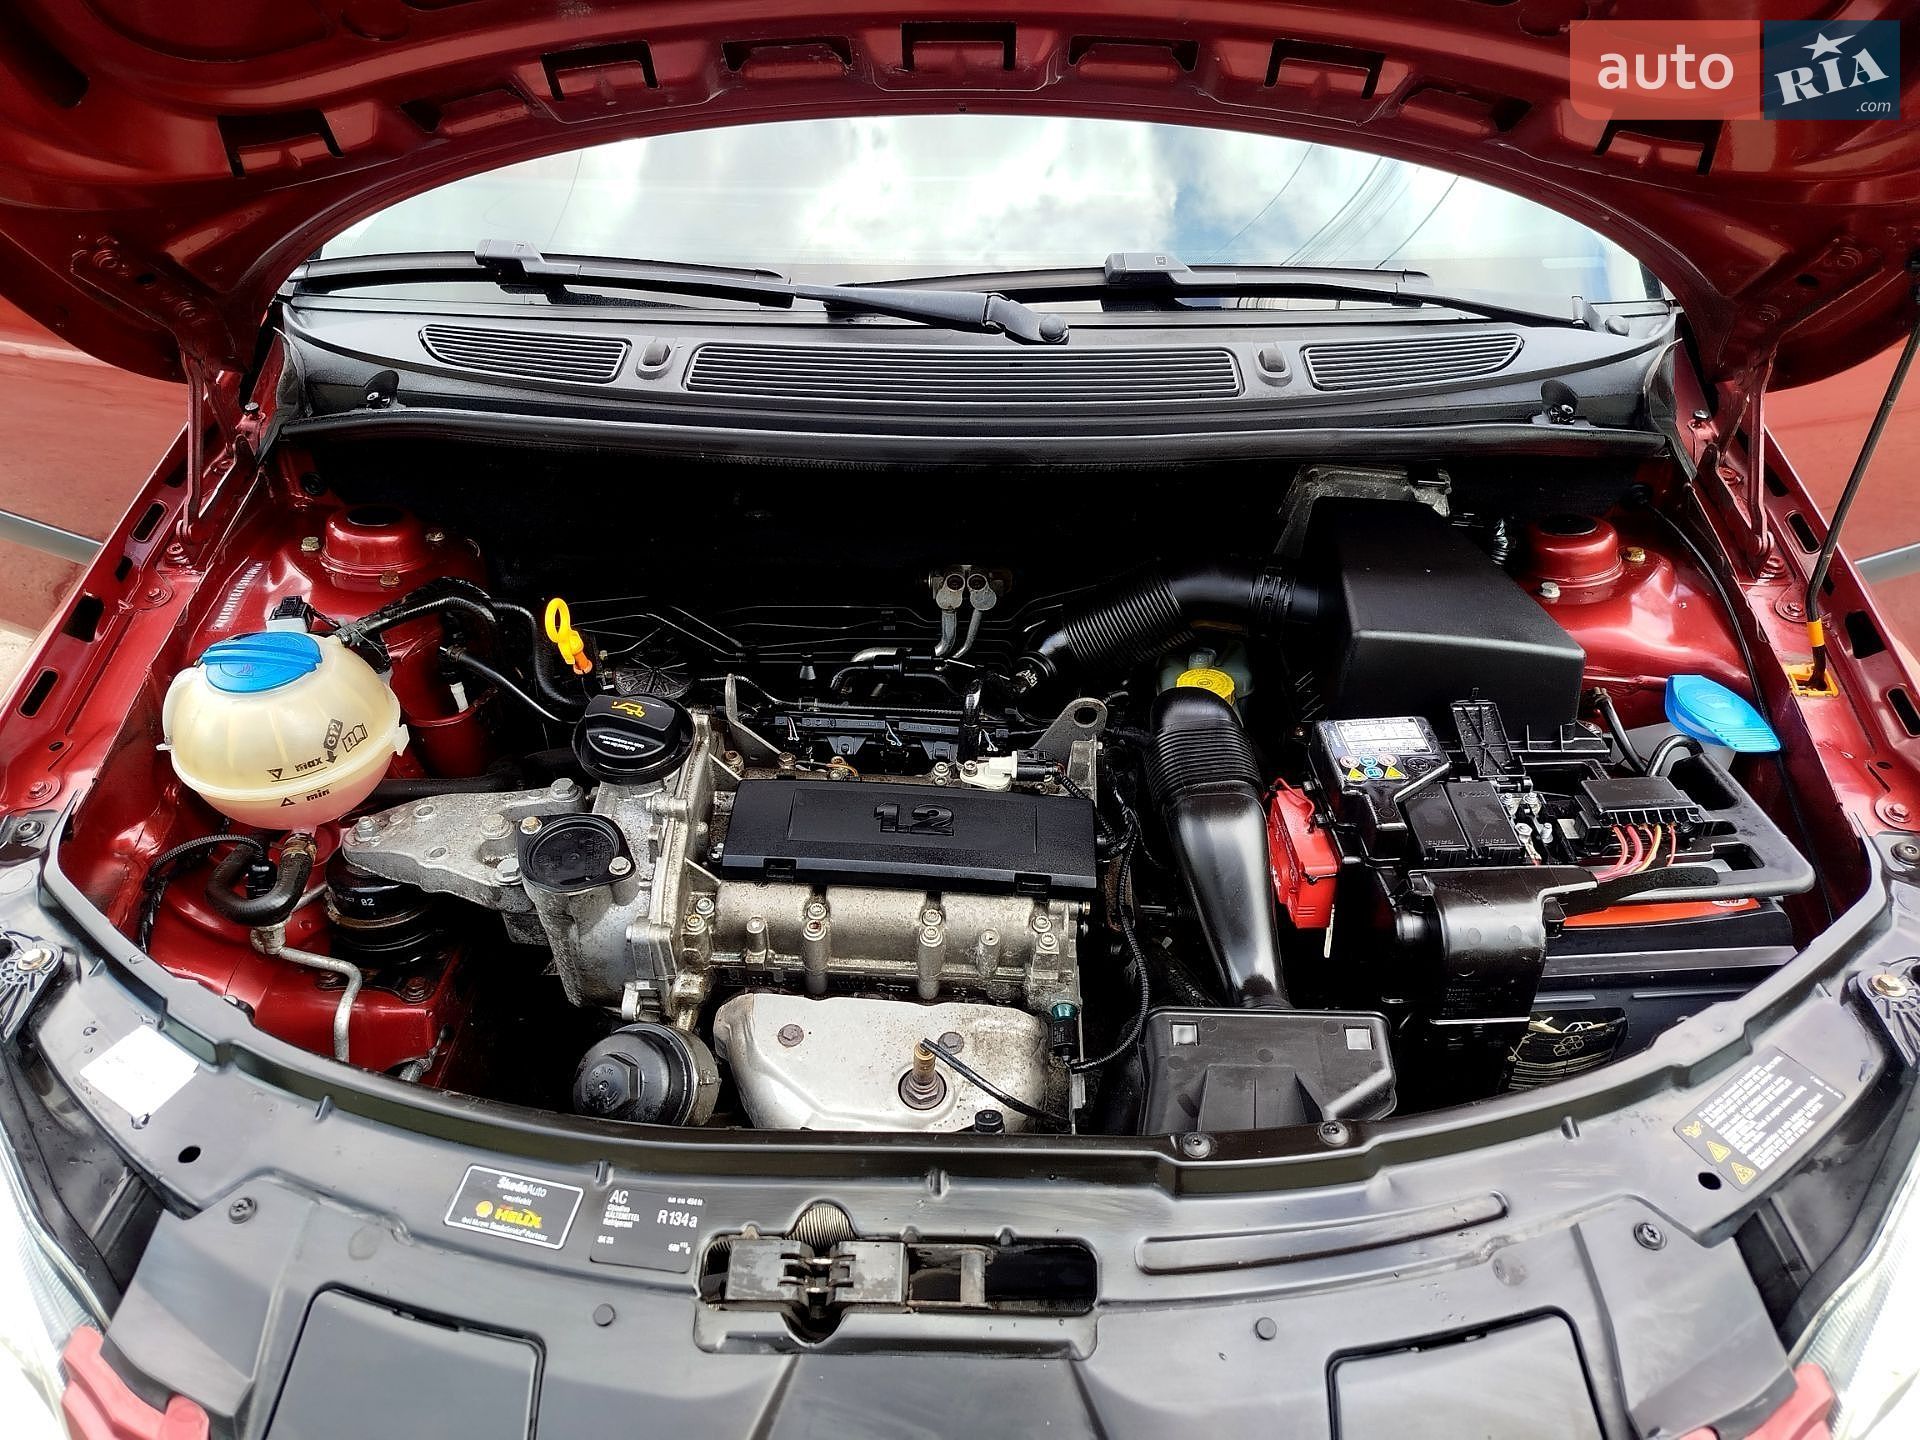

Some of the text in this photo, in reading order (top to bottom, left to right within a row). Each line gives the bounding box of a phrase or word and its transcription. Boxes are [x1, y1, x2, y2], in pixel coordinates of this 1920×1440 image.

[294, 757, 323, 772] max
[306, 789, 330, 801] min
[874, 803, 954, 836] 1.2
[609, 1189, 629, 1205] AC
